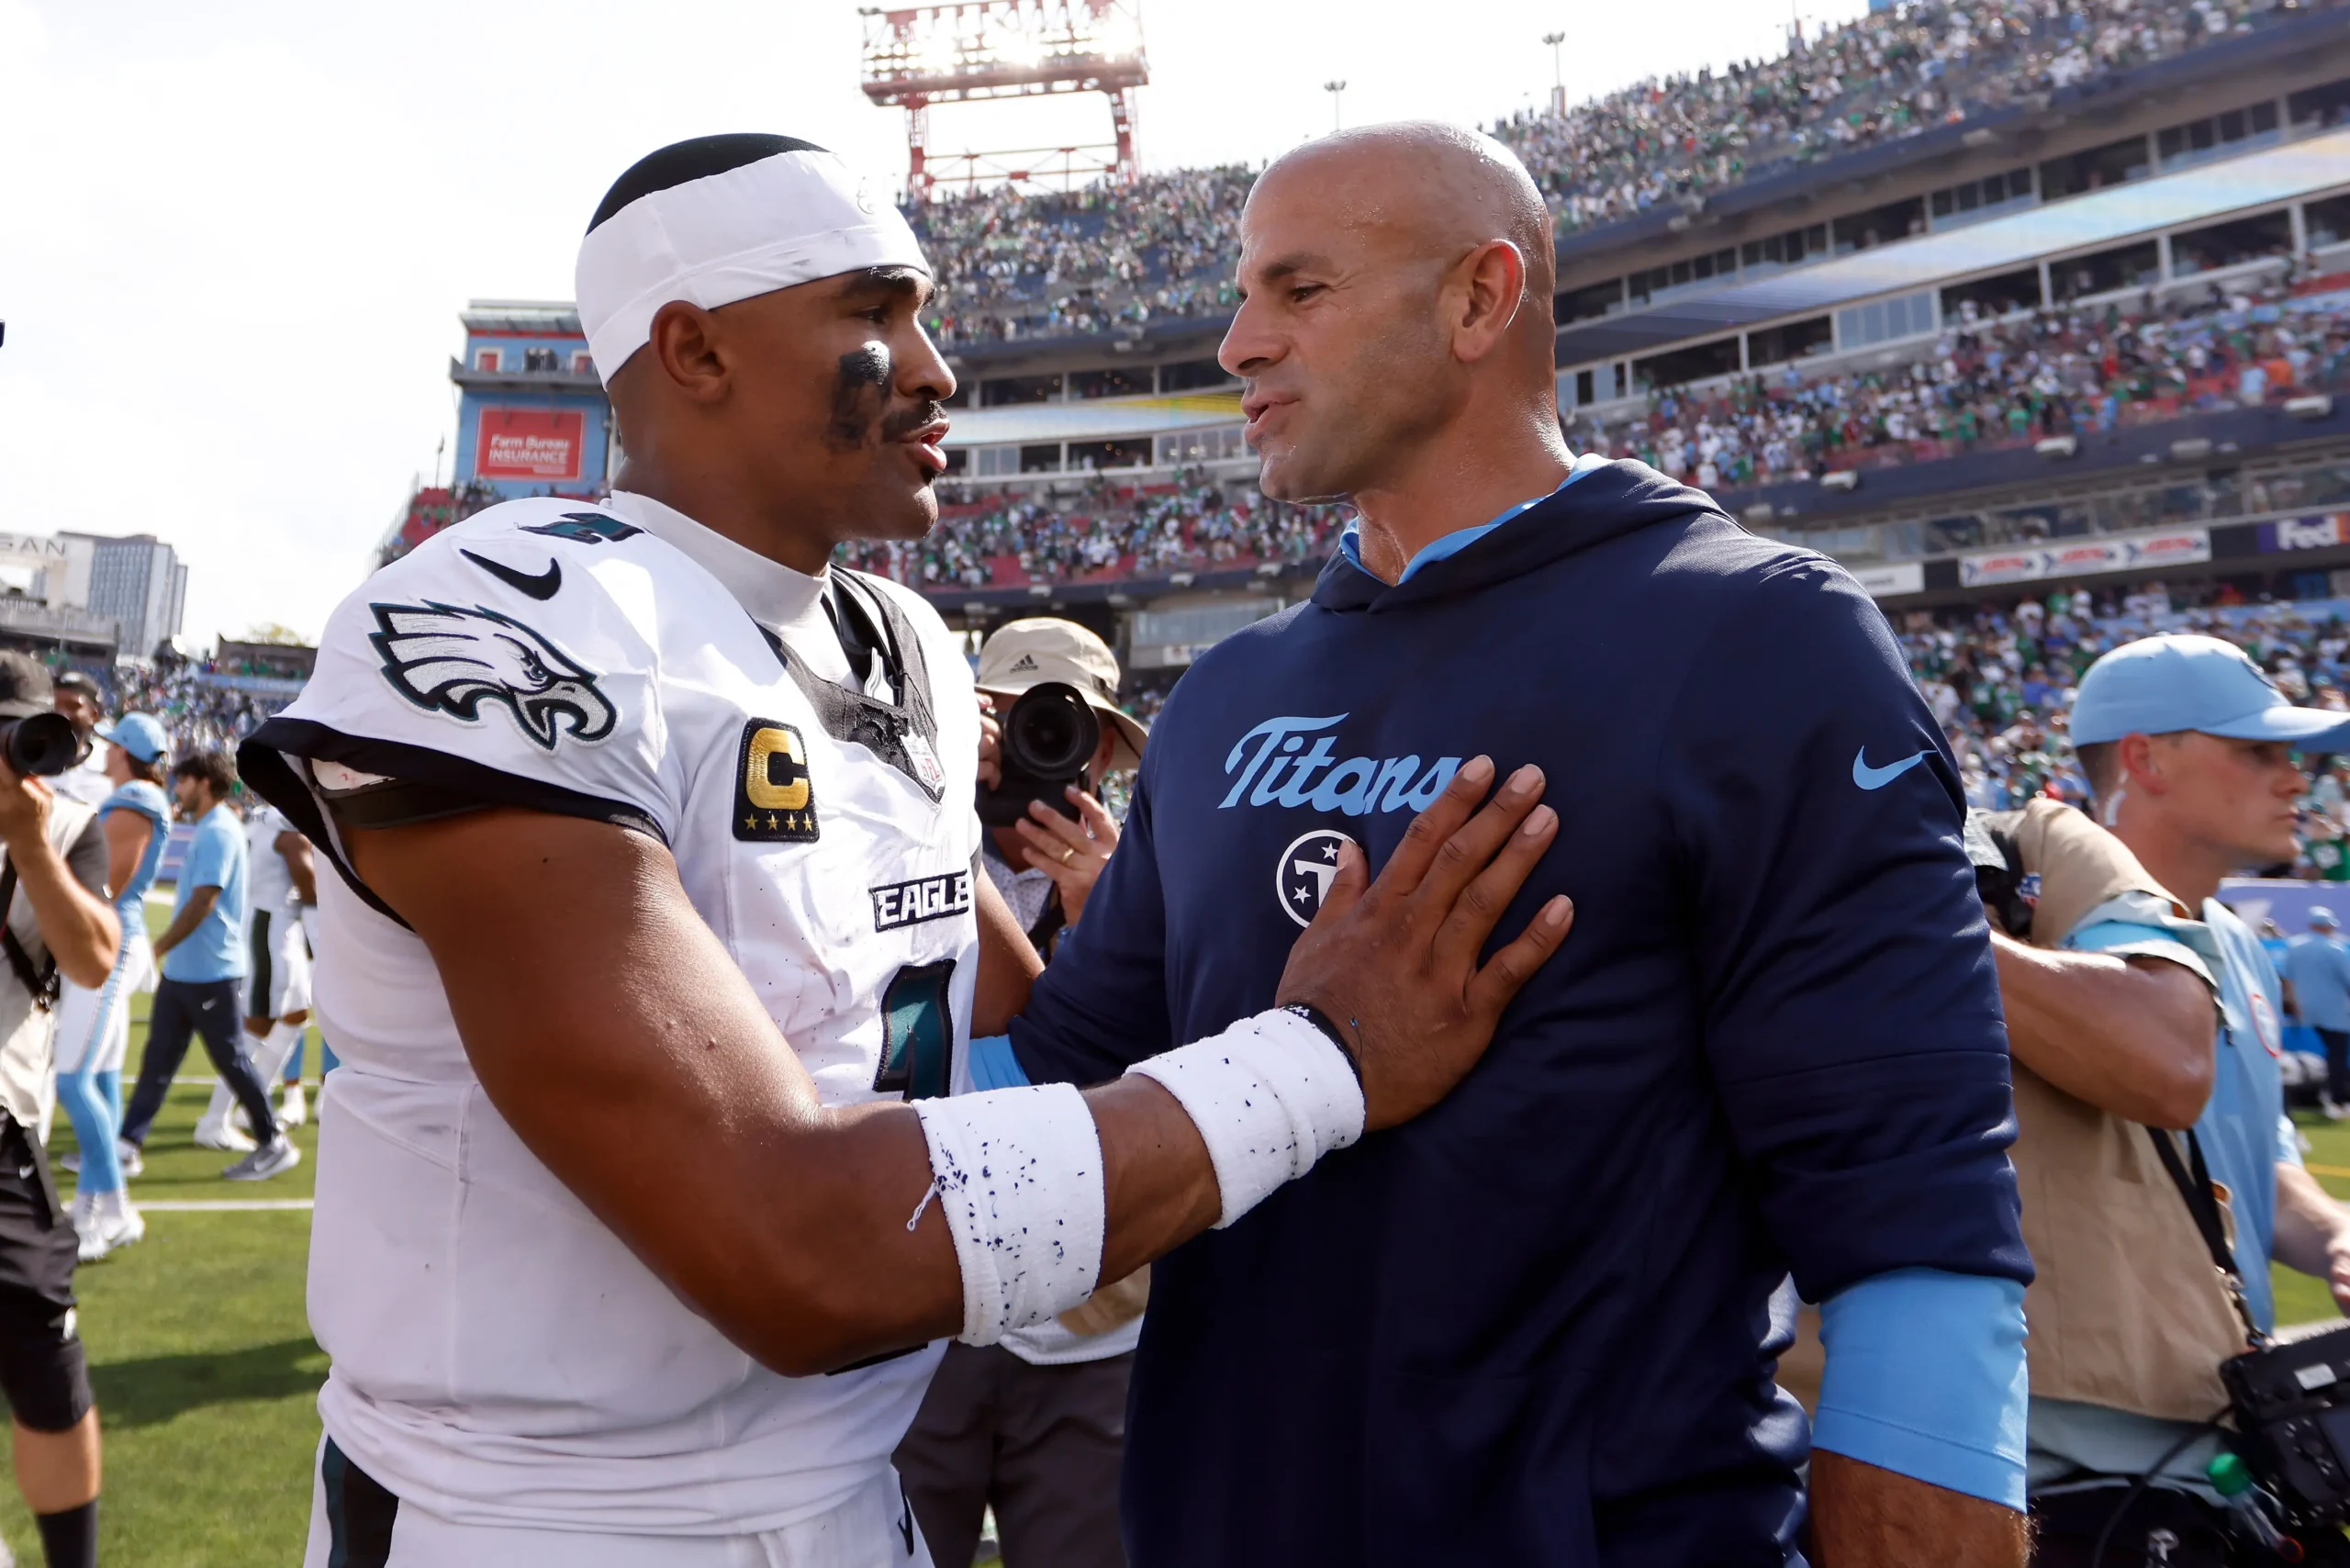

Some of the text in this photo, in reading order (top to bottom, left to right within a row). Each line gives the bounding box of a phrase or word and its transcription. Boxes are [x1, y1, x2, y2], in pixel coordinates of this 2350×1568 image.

[488, 448, 568, 465] INSURANCE
[491, 433, 570, 450] Farm Bureau
[746, 727, 809, 810] C
[1217, 712, 1462, 816] Titans
[875, 876, 968, 926] EAGLE
